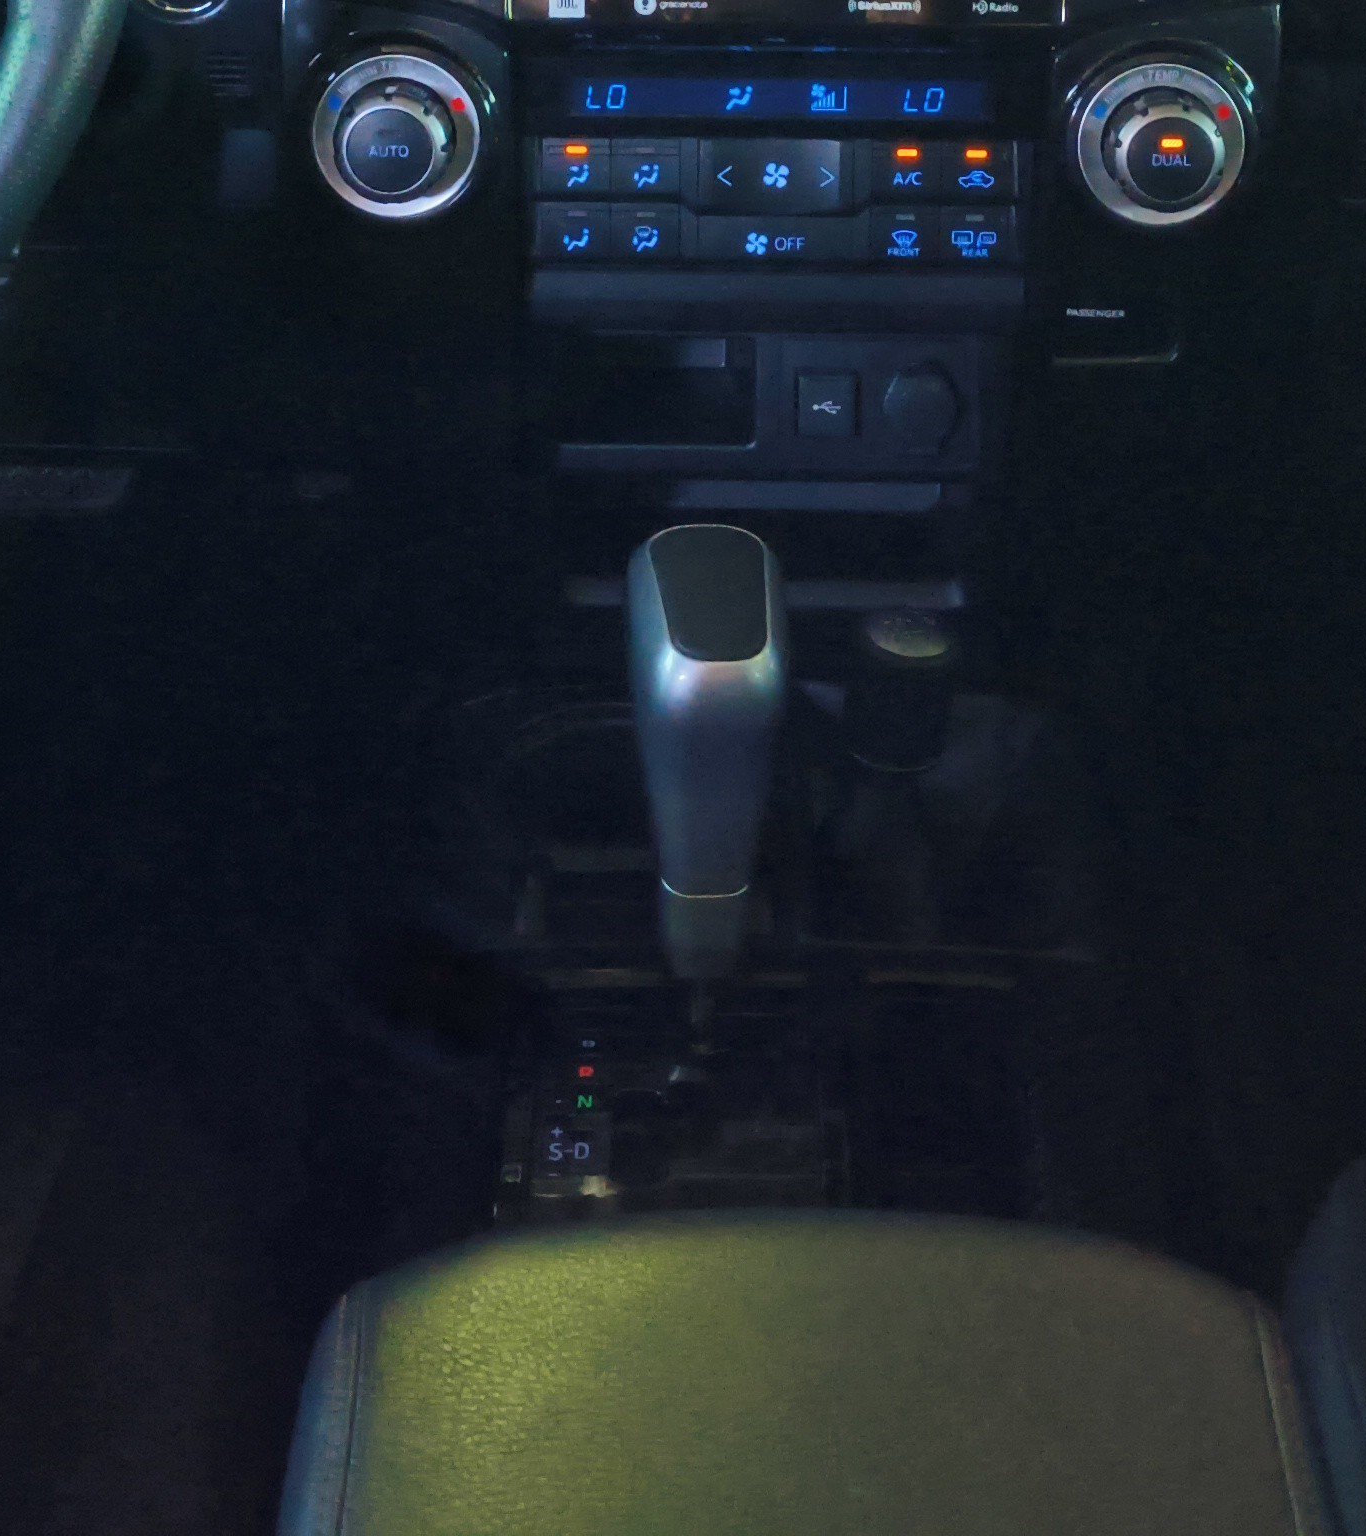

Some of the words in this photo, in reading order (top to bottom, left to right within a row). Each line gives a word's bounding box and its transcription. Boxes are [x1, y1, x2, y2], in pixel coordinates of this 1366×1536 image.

[989, 1, 1020, 13] Radio
[584, 83, 628, 111] LO
[902, 86, 946, 114] LO
[367, 144, 411, 159] AUTO
[1151, 153, 1193, 168] DUAL
[892, 170, 924, 187] A/C
[774, 236, 806, 252] OFF
[886, 246, 921, 258] FRONT
[961, 247, 990, 259] REAR
[576, 1093, 595, 1109] N
